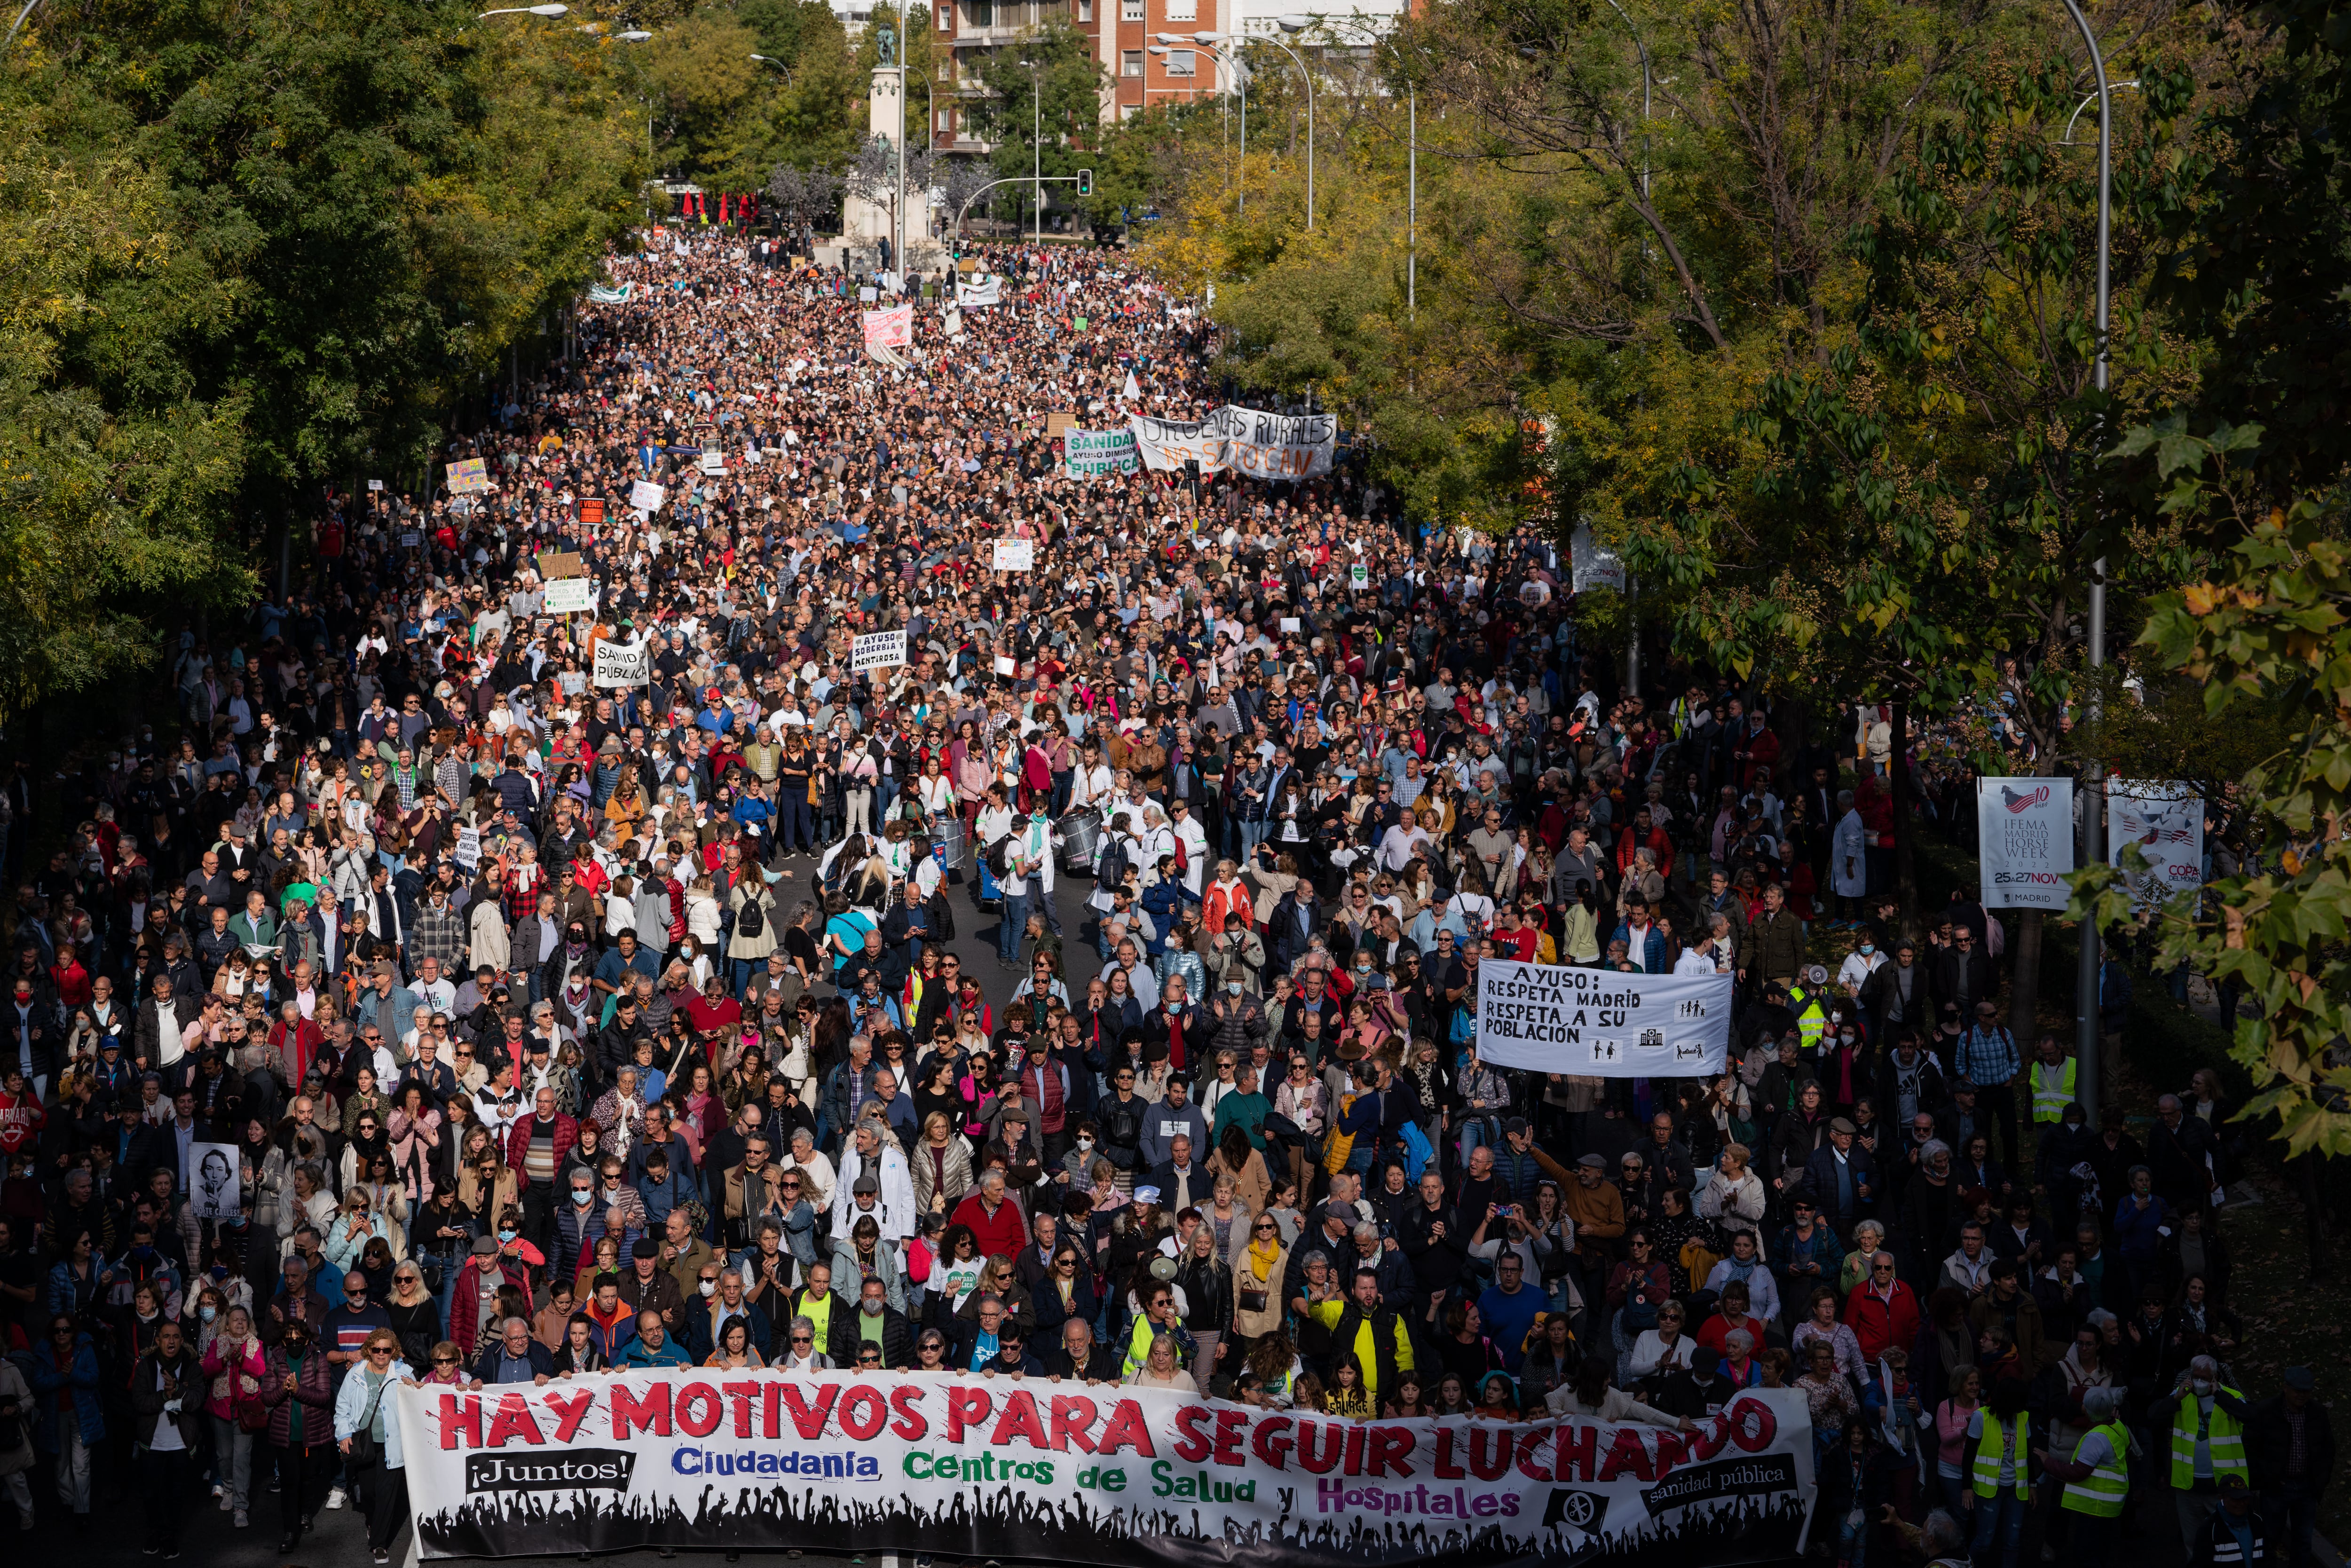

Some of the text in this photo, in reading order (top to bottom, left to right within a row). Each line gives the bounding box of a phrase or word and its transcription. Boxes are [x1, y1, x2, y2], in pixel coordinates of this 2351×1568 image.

[1255, 414, 1333, 444] RURALES
[1071, 431, 1136, 450] SANIDAD
[1164, 446, 1192, 465] NO
[639, 485, 663, 495] DEFENSA
[634, 498, 653, 507] SALUD
[864, 633, 895, 646] AYUSO
[598, 663, 647, 679] PÚBLICA
[2004, 819, 2048, 830] IFEMA
[460, 832, 477, 842] RECORTES
[2005, 838, 2049, 849] HORSE
[459, 842, 476, 852] HOMICIDAS
[2005, 848, 2048, 859] WEEK
[2168, 865, 2199, 877] COPA
[2015, 894, 2051, 903] MADRID
[1487, 979, 1564, 1004] RESPETA
[1486, 1001, 1625, 1027] RESPETA A SU
[1485, 1017, 1580, 1044] POBLACIÓN
[0, 1106, 30, 1127] ARVARD
[205, 1207, 213, 1215] TE
[214, 1207, 240, 1217] CALLES!
[438, 1387, 593, 1451] HAY
[610, 1380, 927, 1441] MOTIVOS
[947, 1386, 1155, 1458] PARA
[1173, 1406, 1416, 1479] SEGUIR
[472, 1455, 628, 1488] ¡Juntos!
[671, 1447, 1519, 1519] Ciudadanía Centros de Salud y Hospitales
[1650, 1462, 1794, 1504] sanidad pública
